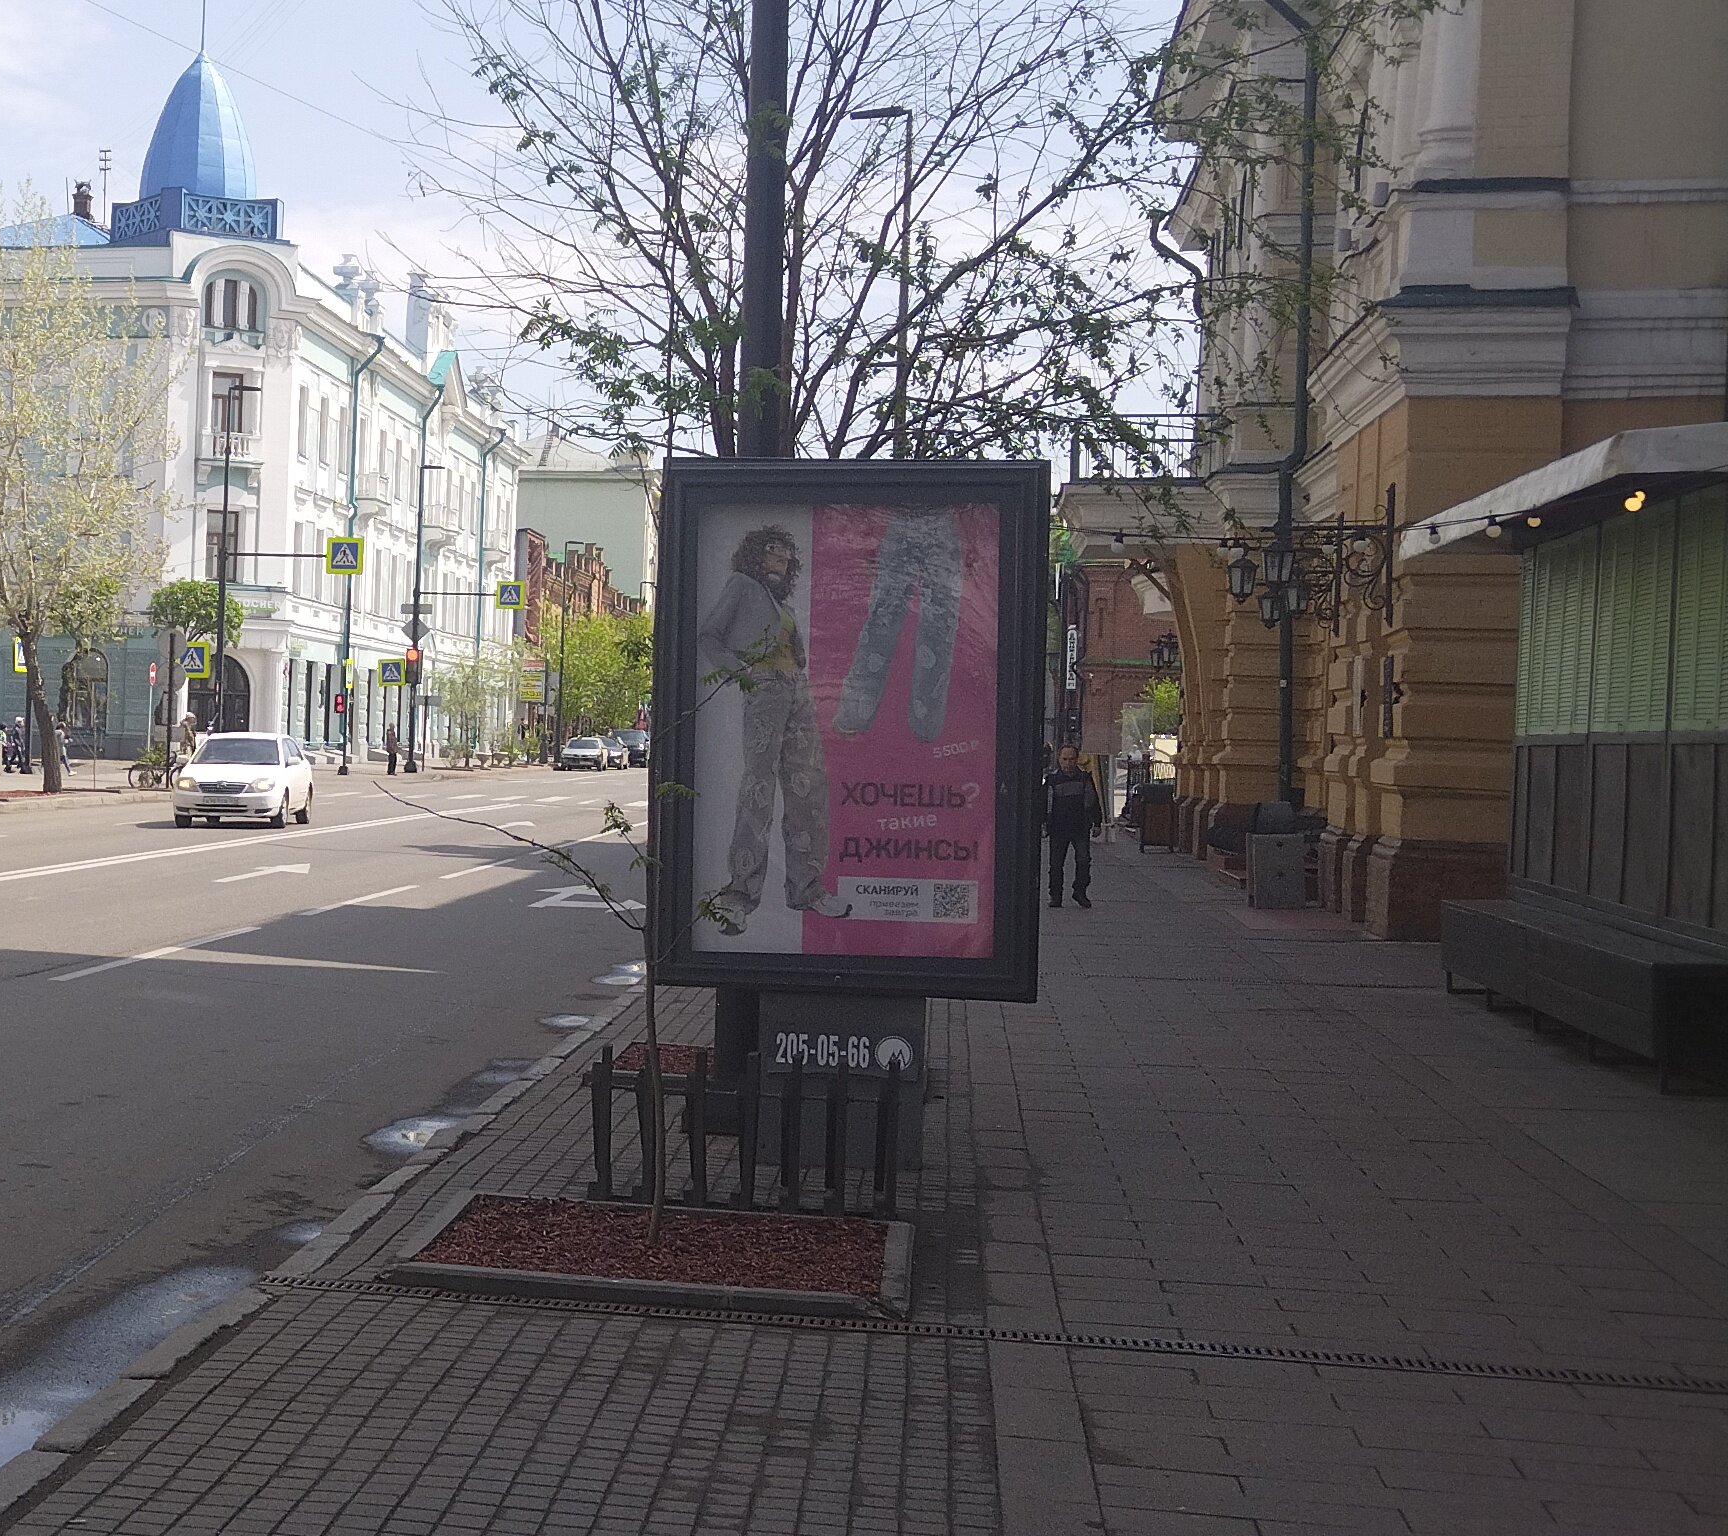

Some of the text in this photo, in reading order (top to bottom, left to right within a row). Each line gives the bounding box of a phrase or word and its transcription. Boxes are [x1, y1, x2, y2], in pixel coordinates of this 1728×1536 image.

[932, 741, 968, 759] 5500
[840, 781, 981, 809] ХОЧЕШЬ?
[877, 813, 938, 831] такие
[838, 836, 978, 863] ДЖИНСЫ
[855, 884, 919, 897] СКАНИРУЙ
[775, 1031, 870, 1068] 205-05-66
